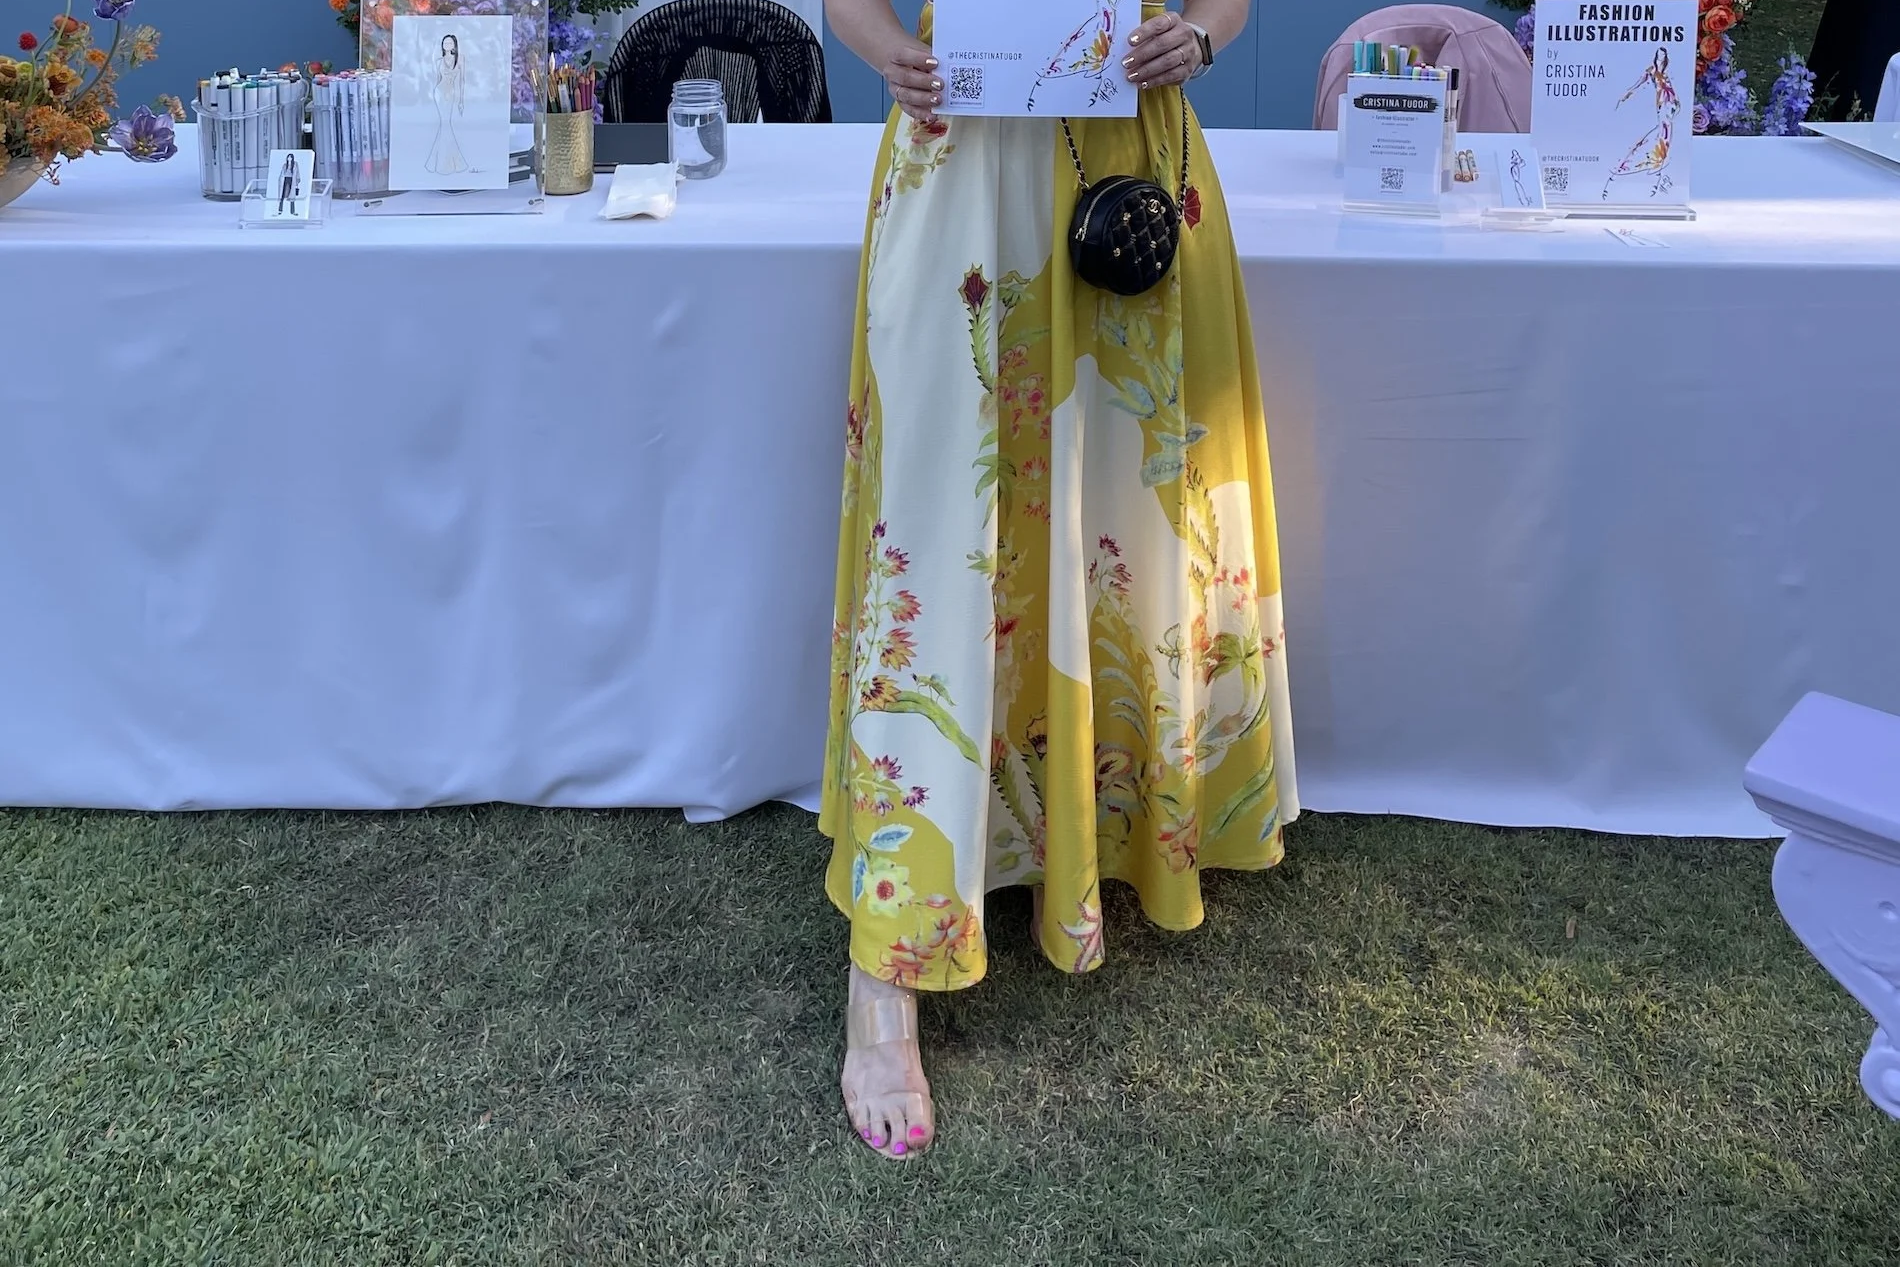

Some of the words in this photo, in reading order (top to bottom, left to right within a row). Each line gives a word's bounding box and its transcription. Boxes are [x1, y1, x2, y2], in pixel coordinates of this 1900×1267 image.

[1579, 4, 1655, 21] FASHION
[1547, 25, 1684, 42] ILLUSTRATIONS
[1546, 48, 1559, 60] by
[1545, 64, 1605, 78] CRISTINA
[1545, 83, 1587, 97] TUDOR
[1362, 97, 1400, 108] CRISTINA
[1402, 99, 1429, 109] TUDOR
